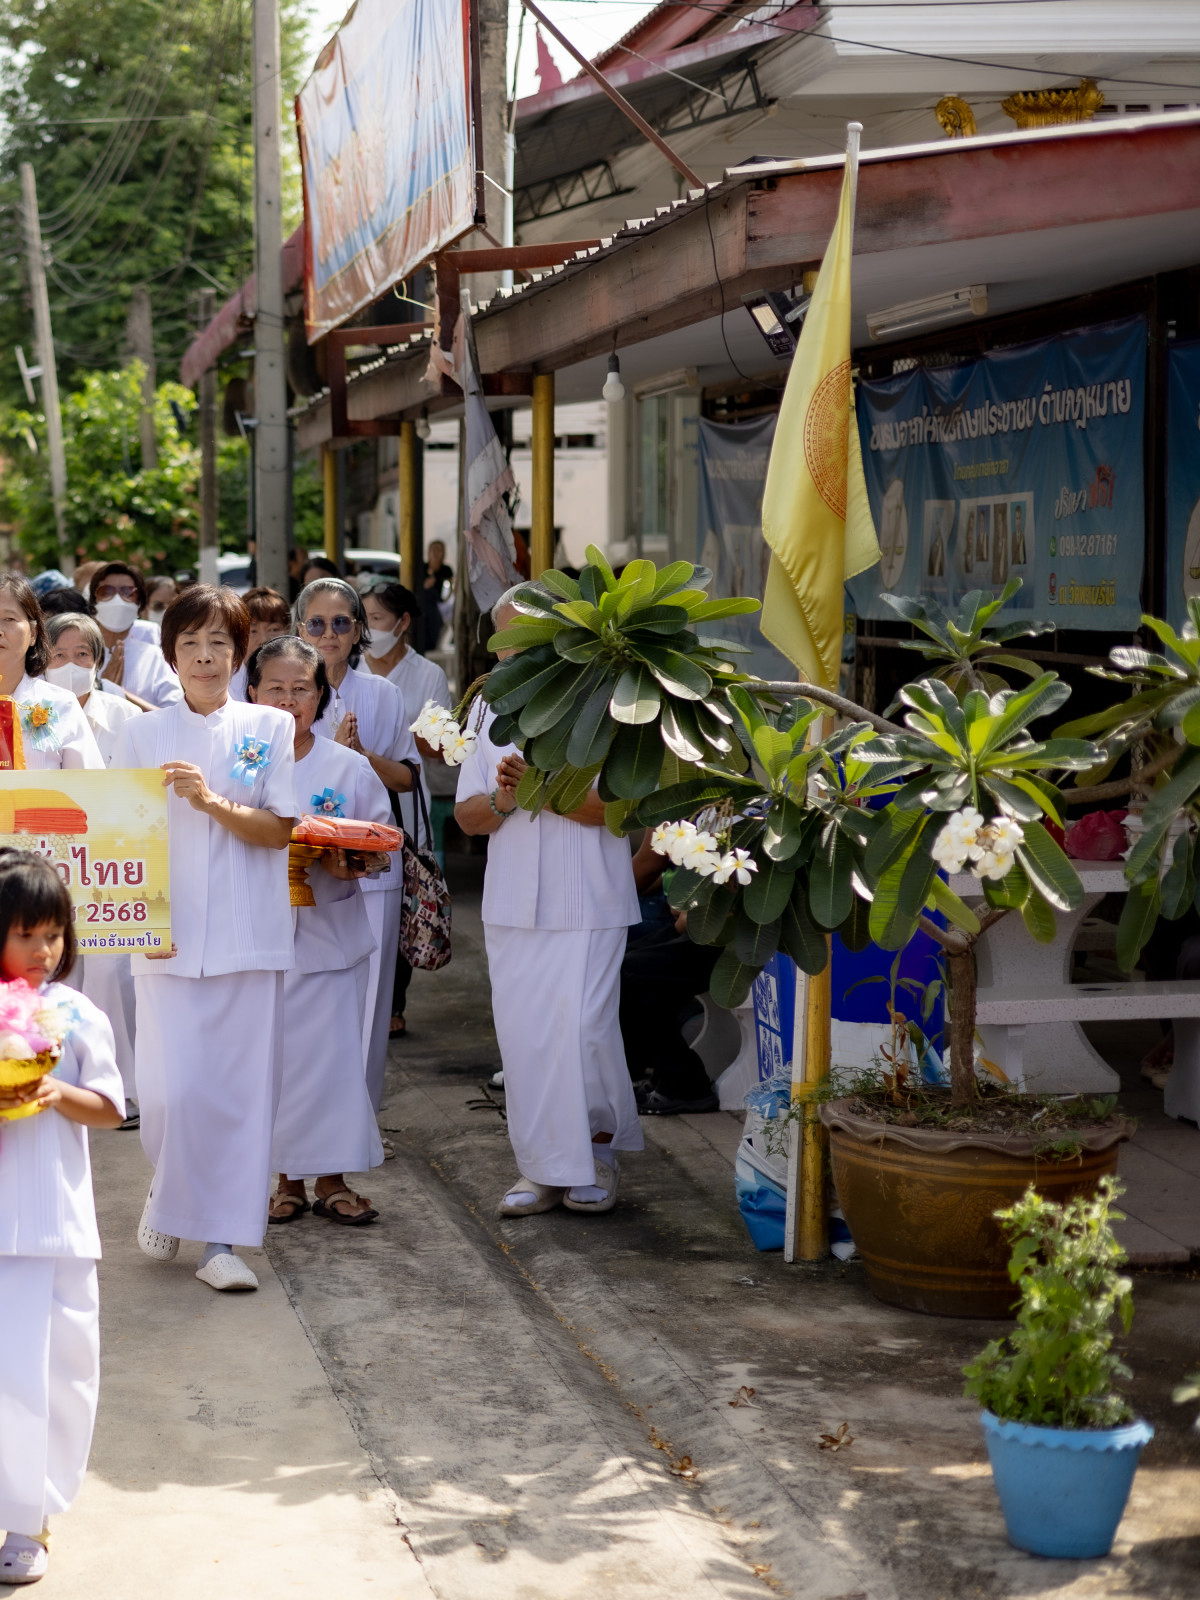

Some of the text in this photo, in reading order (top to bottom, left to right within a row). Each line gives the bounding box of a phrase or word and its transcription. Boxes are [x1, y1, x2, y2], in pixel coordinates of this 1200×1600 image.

[1038, 379, 1131, 430] ด้านกฎหมาย
[86, 903, 146, 922] 2568
